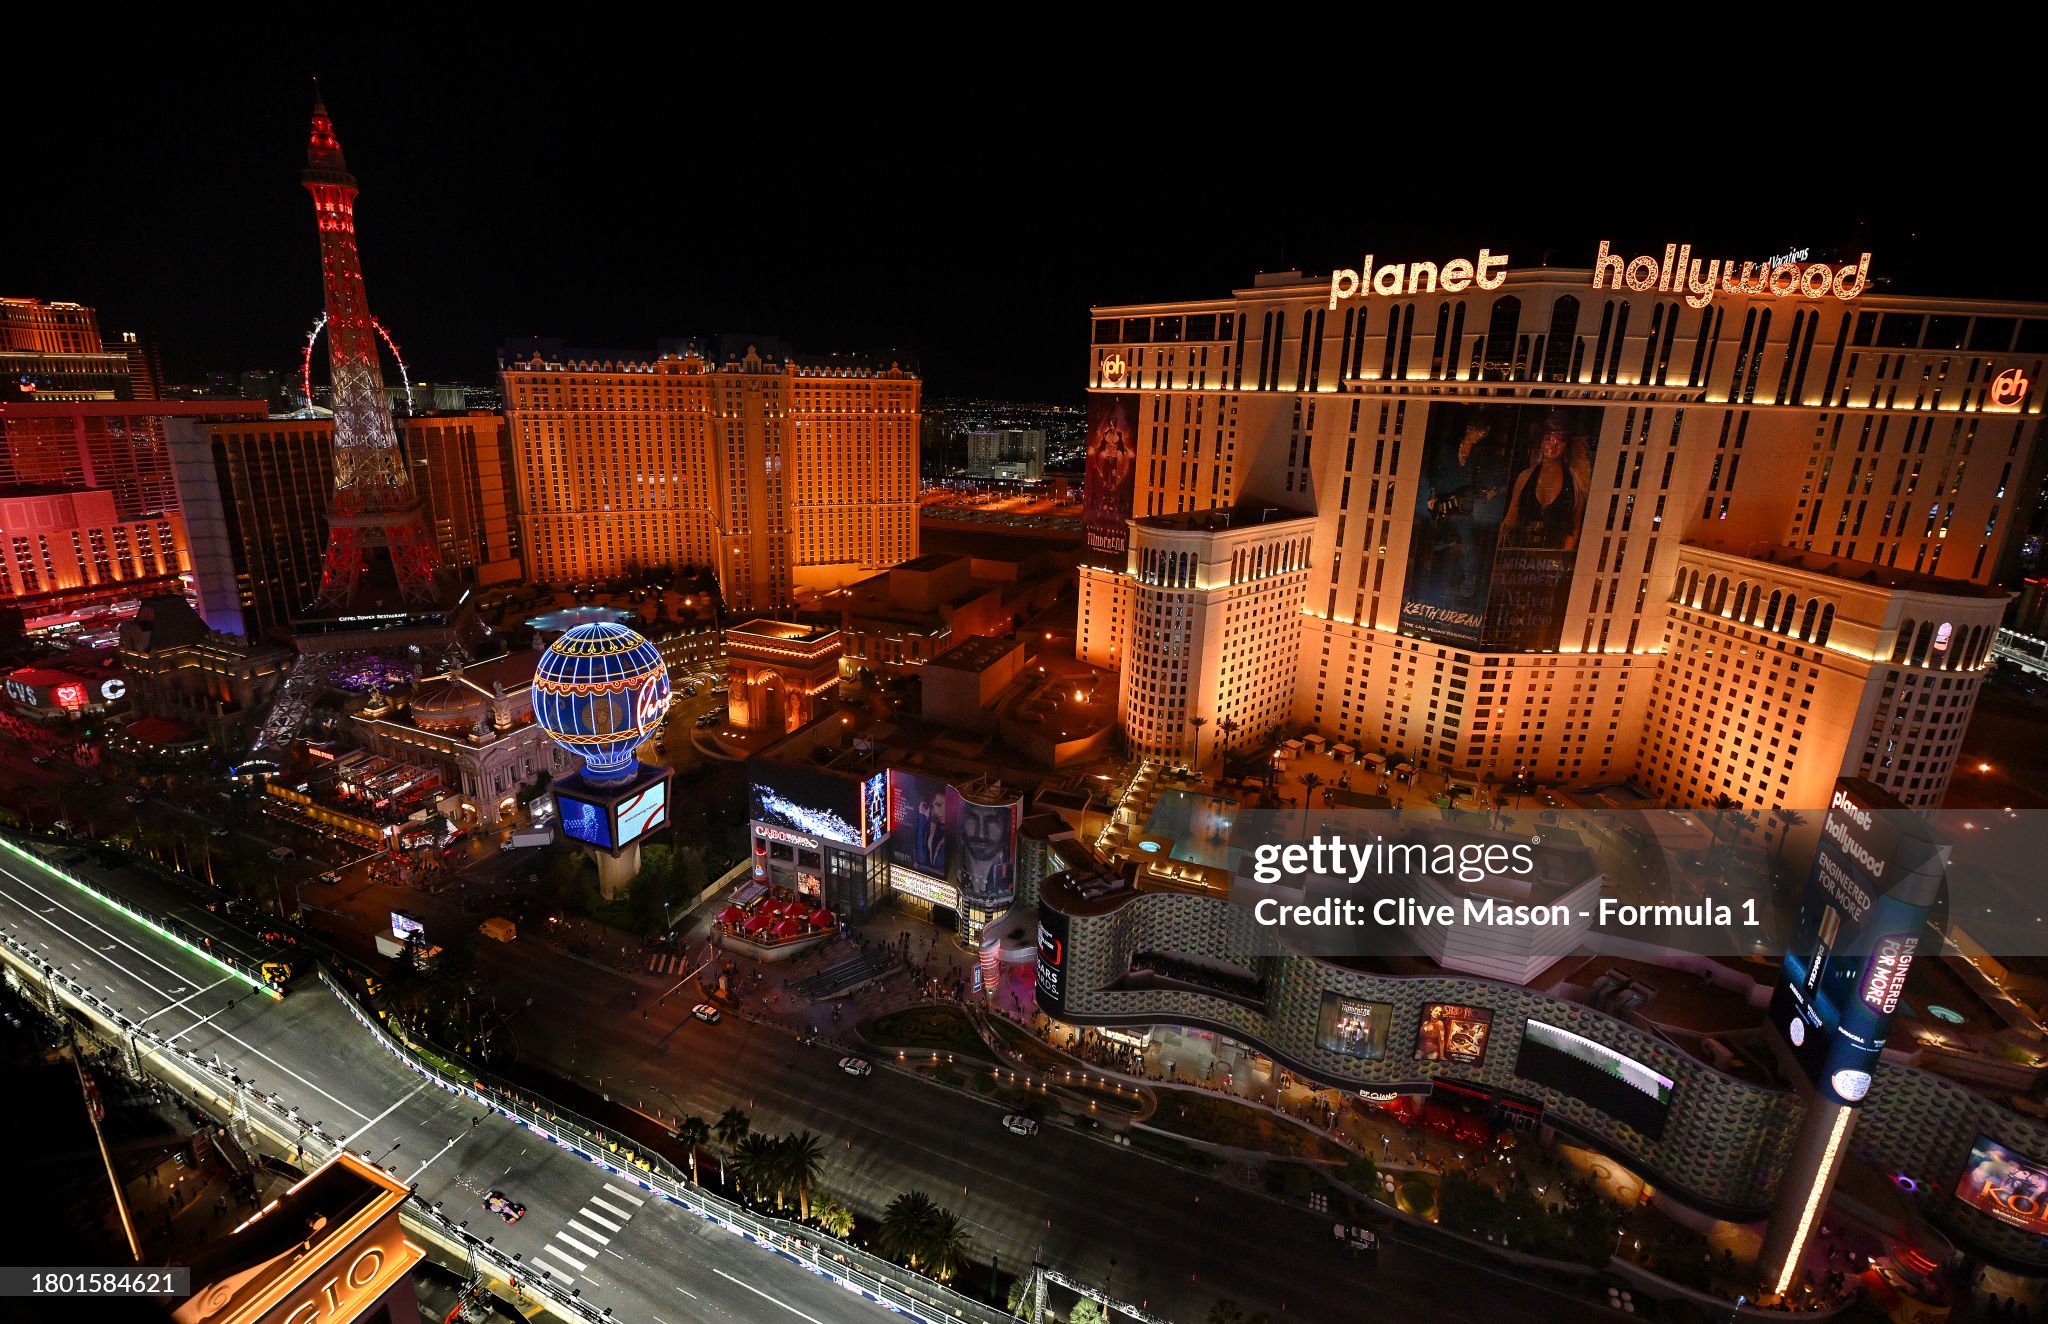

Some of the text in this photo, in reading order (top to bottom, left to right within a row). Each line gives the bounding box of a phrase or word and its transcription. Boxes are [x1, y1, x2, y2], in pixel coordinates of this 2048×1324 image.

[1329, 240, 1872, 311] planet hollywood
[1105, 354, 1126, 379] ph
[1994, 369, 2029, 402] ph
[1403, 601, 1484, 628] KEITH URBAN
[5, 679, 37, 706] CVS
[636, 675, 673, 737] Paris
[1831, 790, 1873, 831] planet
[1824, 812, 1886, 878] hollywood
[1818, 852, 1871, 911] ENGINEERED
[1818, 870, 1863, 922] FOR MORE
[1808, 944, 1825, 990] DURACELL
[1865, 939, 1901, 1006] FOR MORE
[1882, 937, 1919, 1015] ENGINEERED
